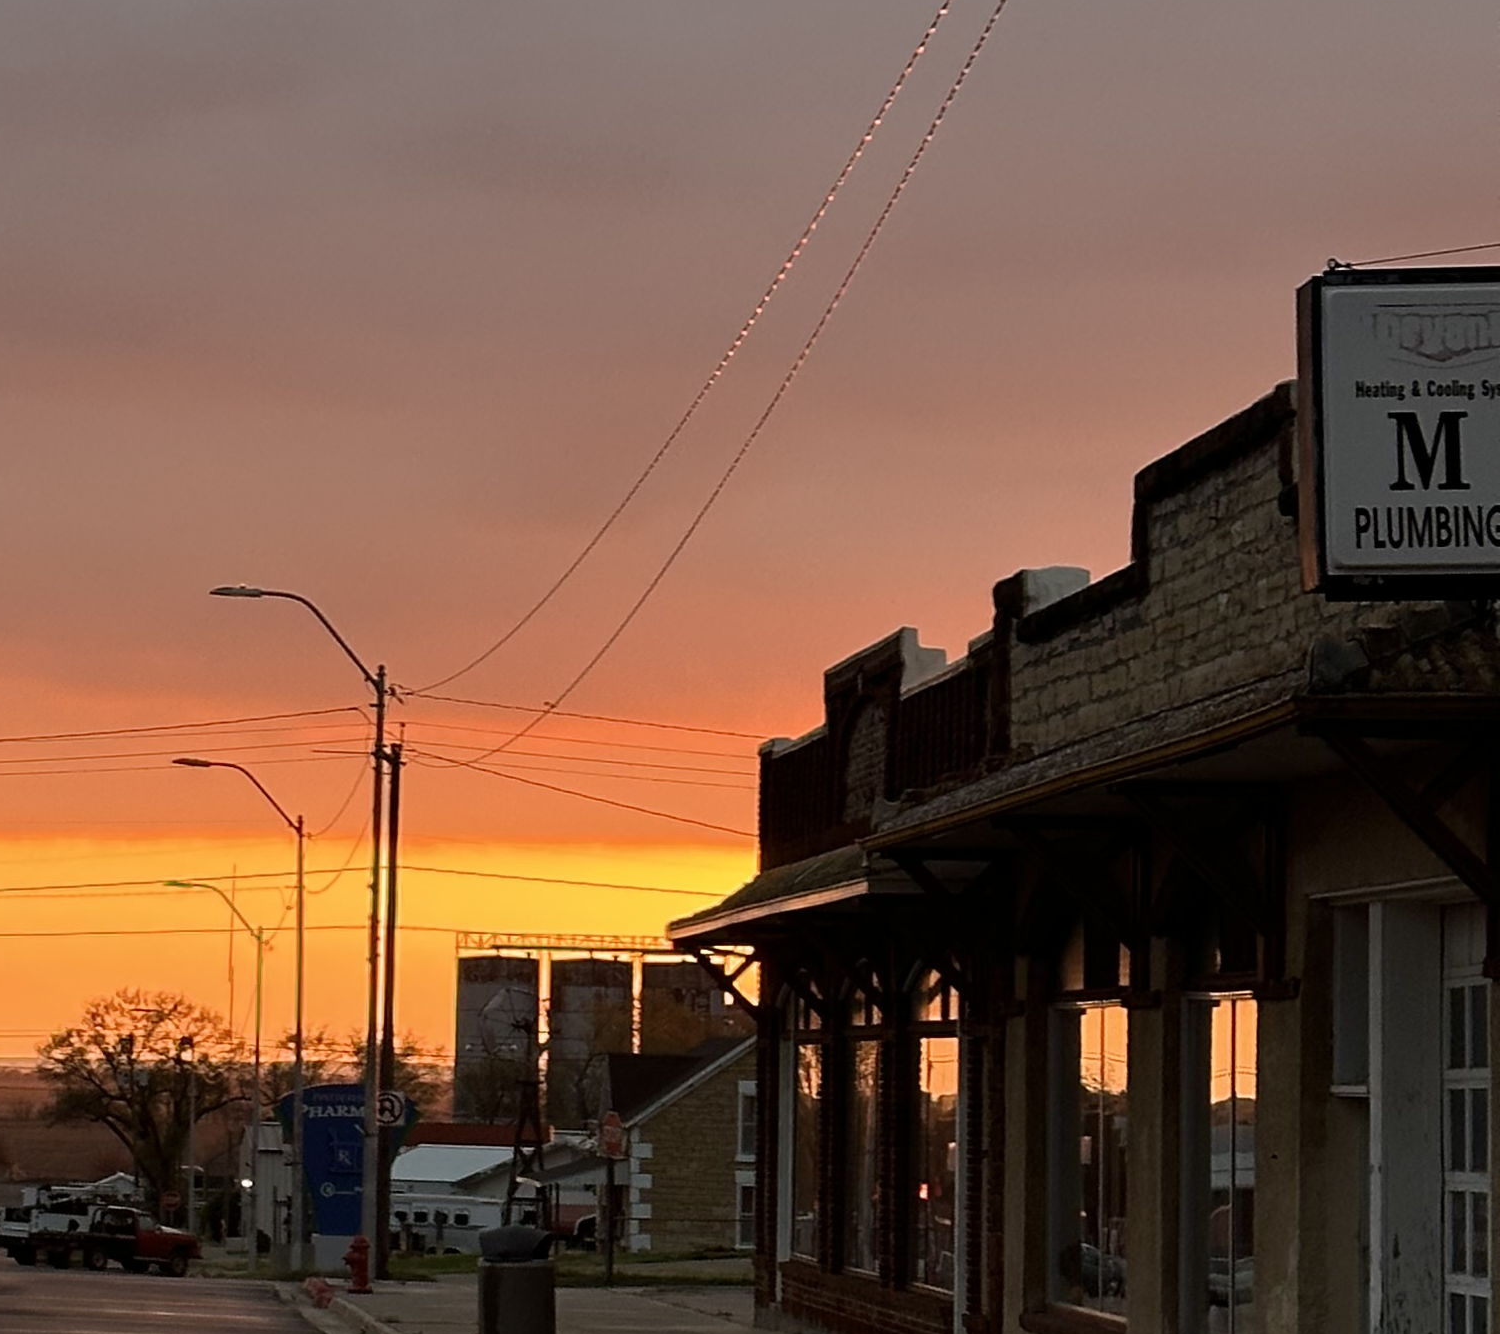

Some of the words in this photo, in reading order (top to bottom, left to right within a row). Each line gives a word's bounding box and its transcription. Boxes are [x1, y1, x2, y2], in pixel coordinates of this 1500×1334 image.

[1355, 380, 1406, 401] Heating
[1411, 380, 1422, 397] &
[1426, 379, 1476, 401] Cooling
[1387, 410, 1472, 491] M
[1355, 504, 1500, 550] PLUMBING
